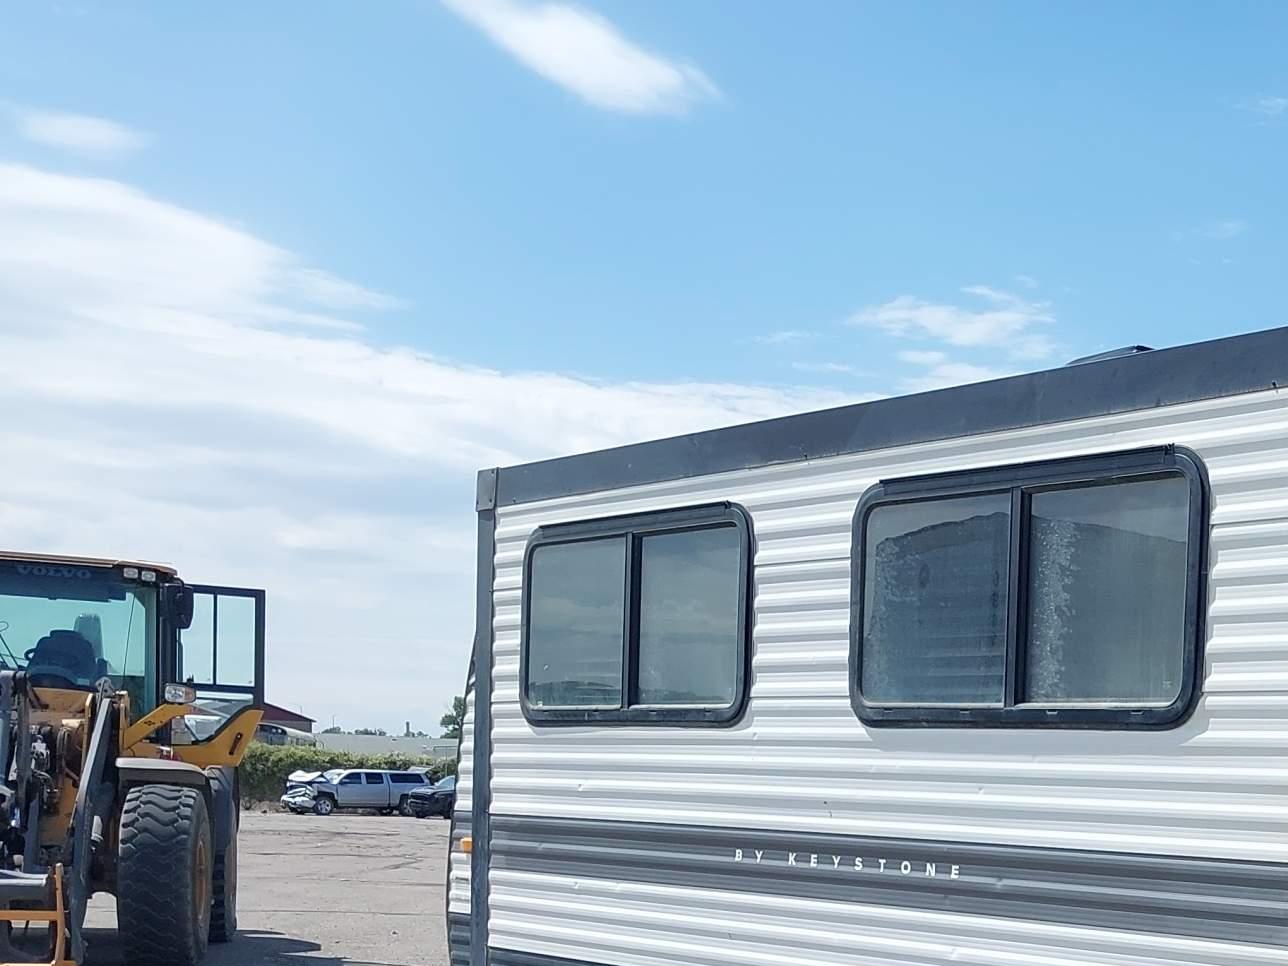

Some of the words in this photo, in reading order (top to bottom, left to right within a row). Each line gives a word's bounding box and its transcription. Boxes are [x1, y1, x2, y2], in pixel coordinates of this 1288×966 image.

[17, 565, 92, 579] VOLVO
[734, 849, 764, 863] BY
[788, 852, 960, 879] KEYSTONE
